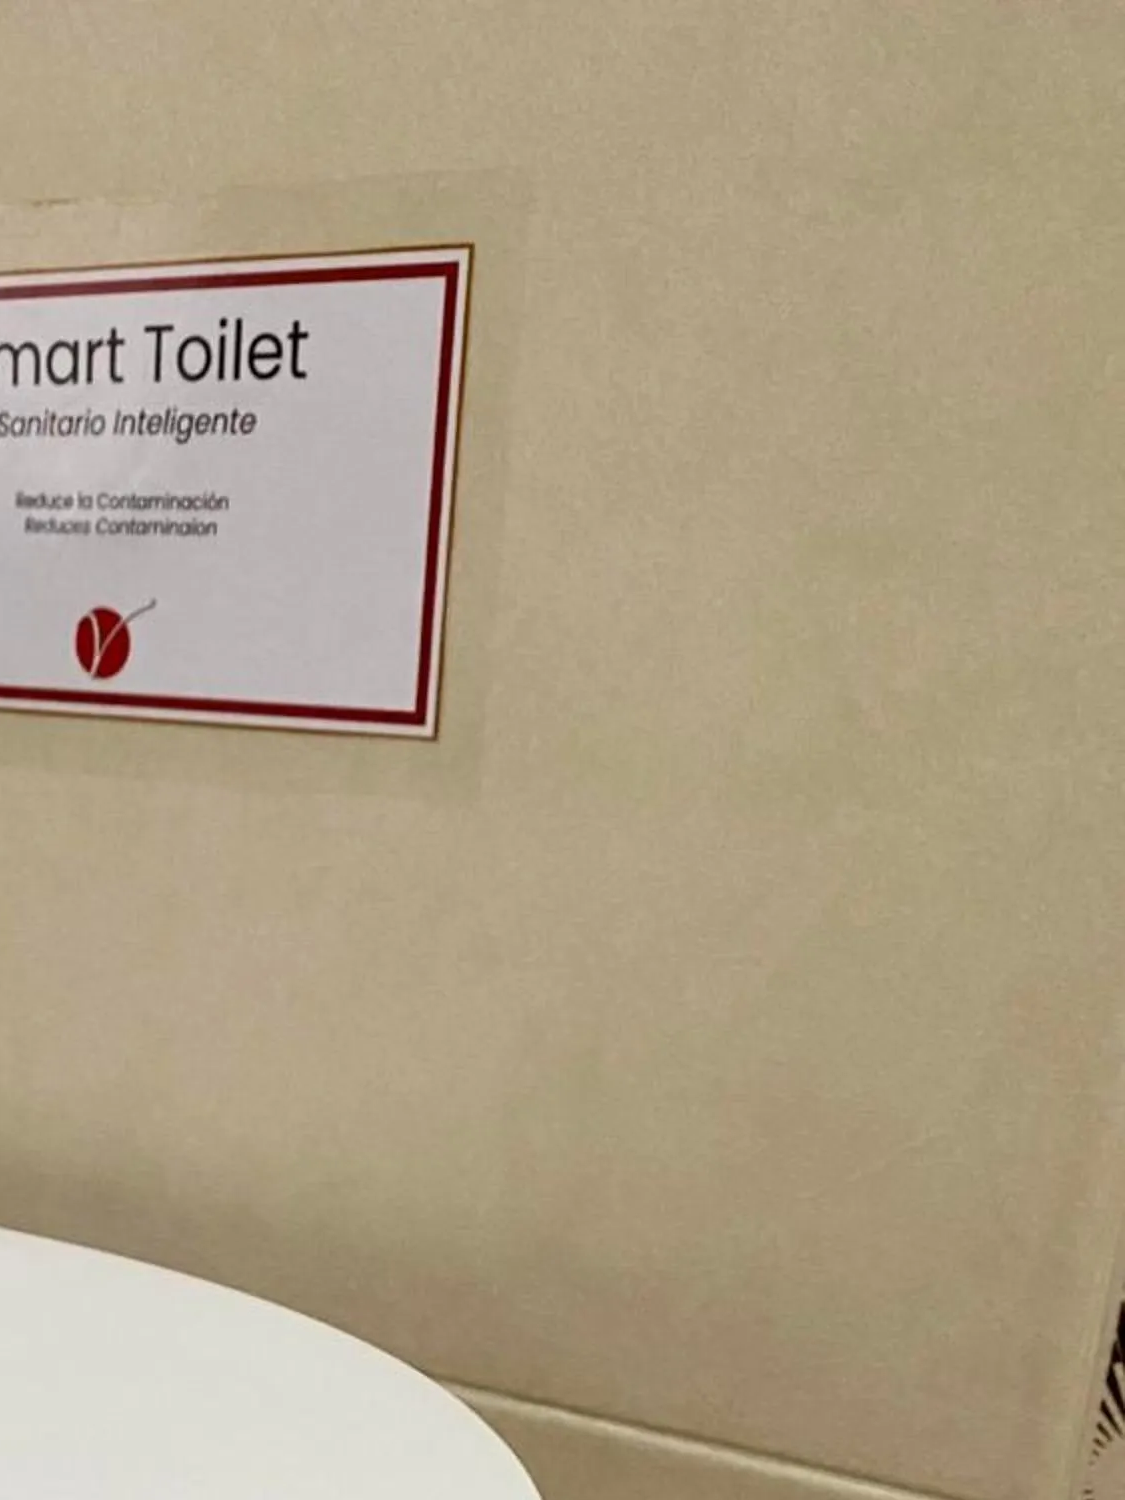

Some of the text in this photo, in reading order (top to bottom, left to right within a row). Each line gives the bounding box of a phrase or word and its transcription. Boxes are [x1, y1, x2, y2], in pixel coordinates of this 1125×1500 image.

[144, 317, 309, 383] Toilet
[113, 407, 257, 444] Inteligente
[15, 492, 229, 512] Reduce la Contaminación
[24, 517, 89, 535] Reduces
